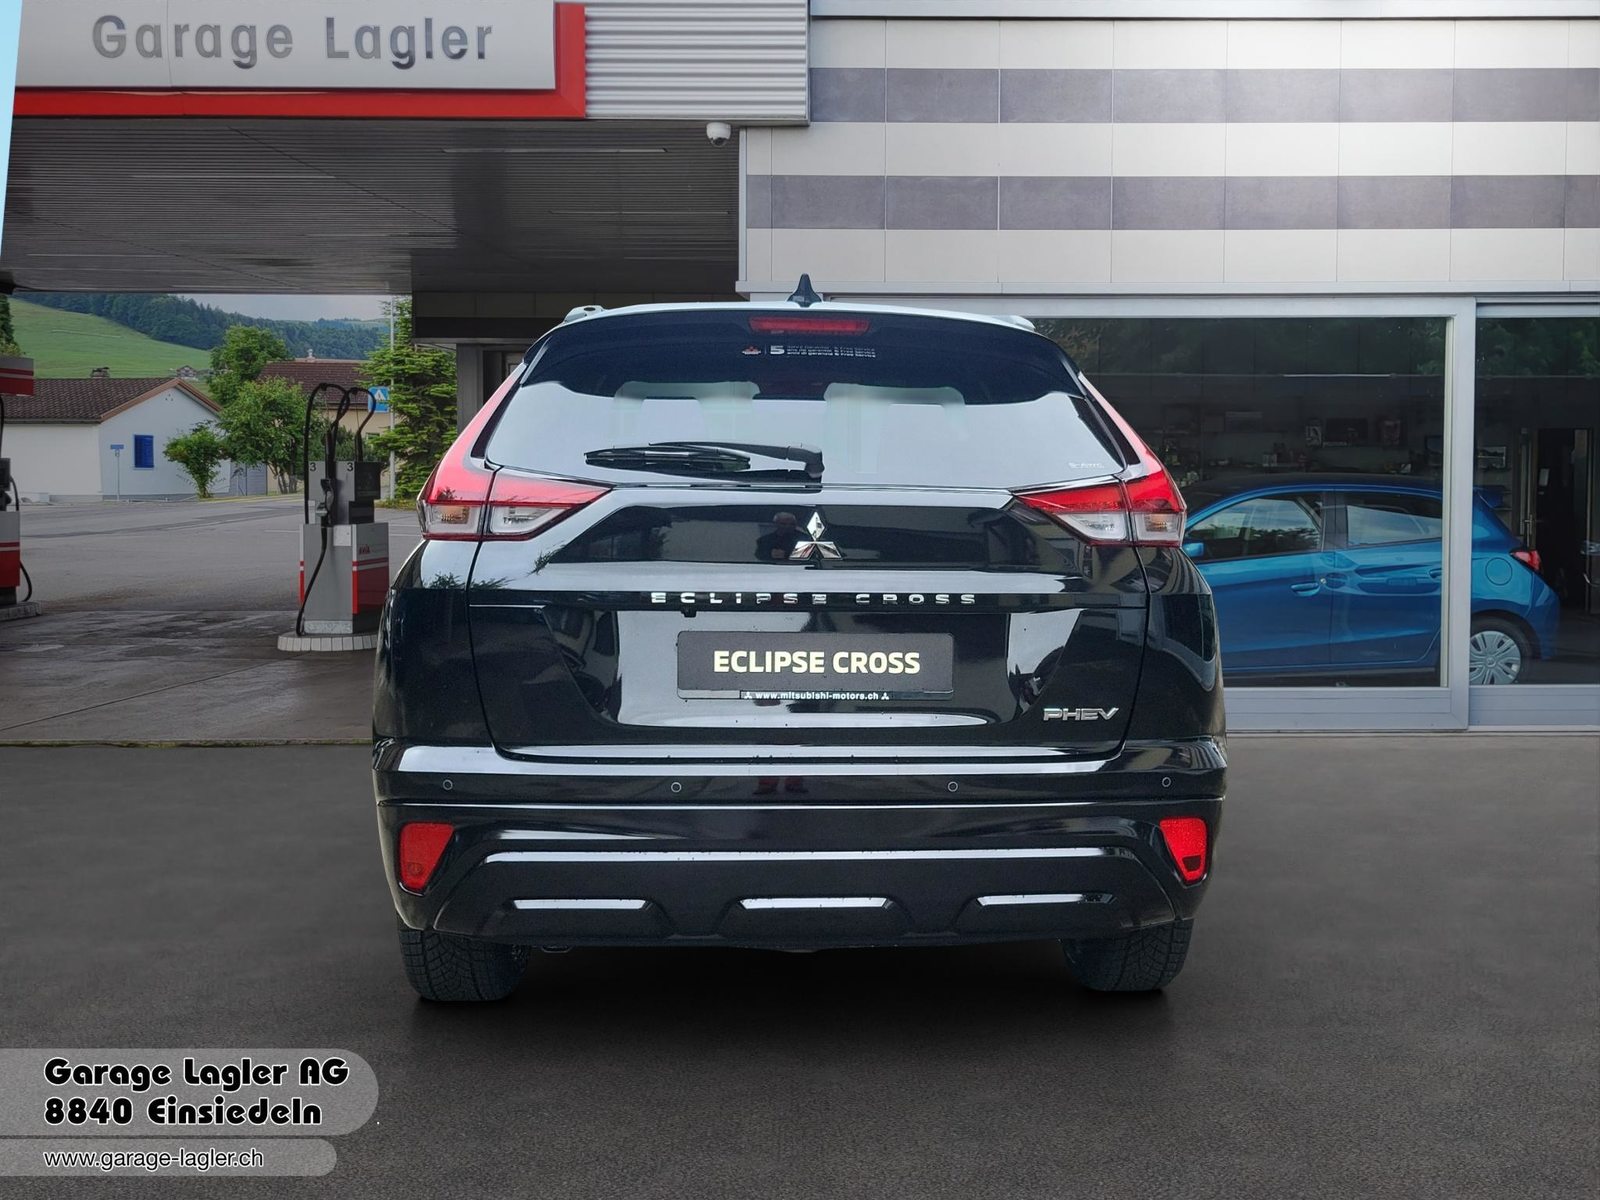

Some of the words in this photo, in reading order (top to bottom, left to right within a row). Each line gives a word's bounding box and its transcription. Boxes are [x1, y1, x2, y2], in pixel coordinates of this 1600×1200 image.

[92, 15, 293, 70] Garage
[325, 17, 492, 70] Lagler
[770, 345, 785, 355] 5
[309, 462, 317, 472] 3
[346, 462, 354, 472] 3
[650, 592, 827, 605] ECLIPSE
[855, 593, 976, 605] CROSS
[713, 650, 825, 674] ECLIPSE
[832, 651, 921, 675] CROSS
[755, 691, 879, 701] www.mitsubishi-motors.ch
[1042, 707, 1119, 721] PHEV
